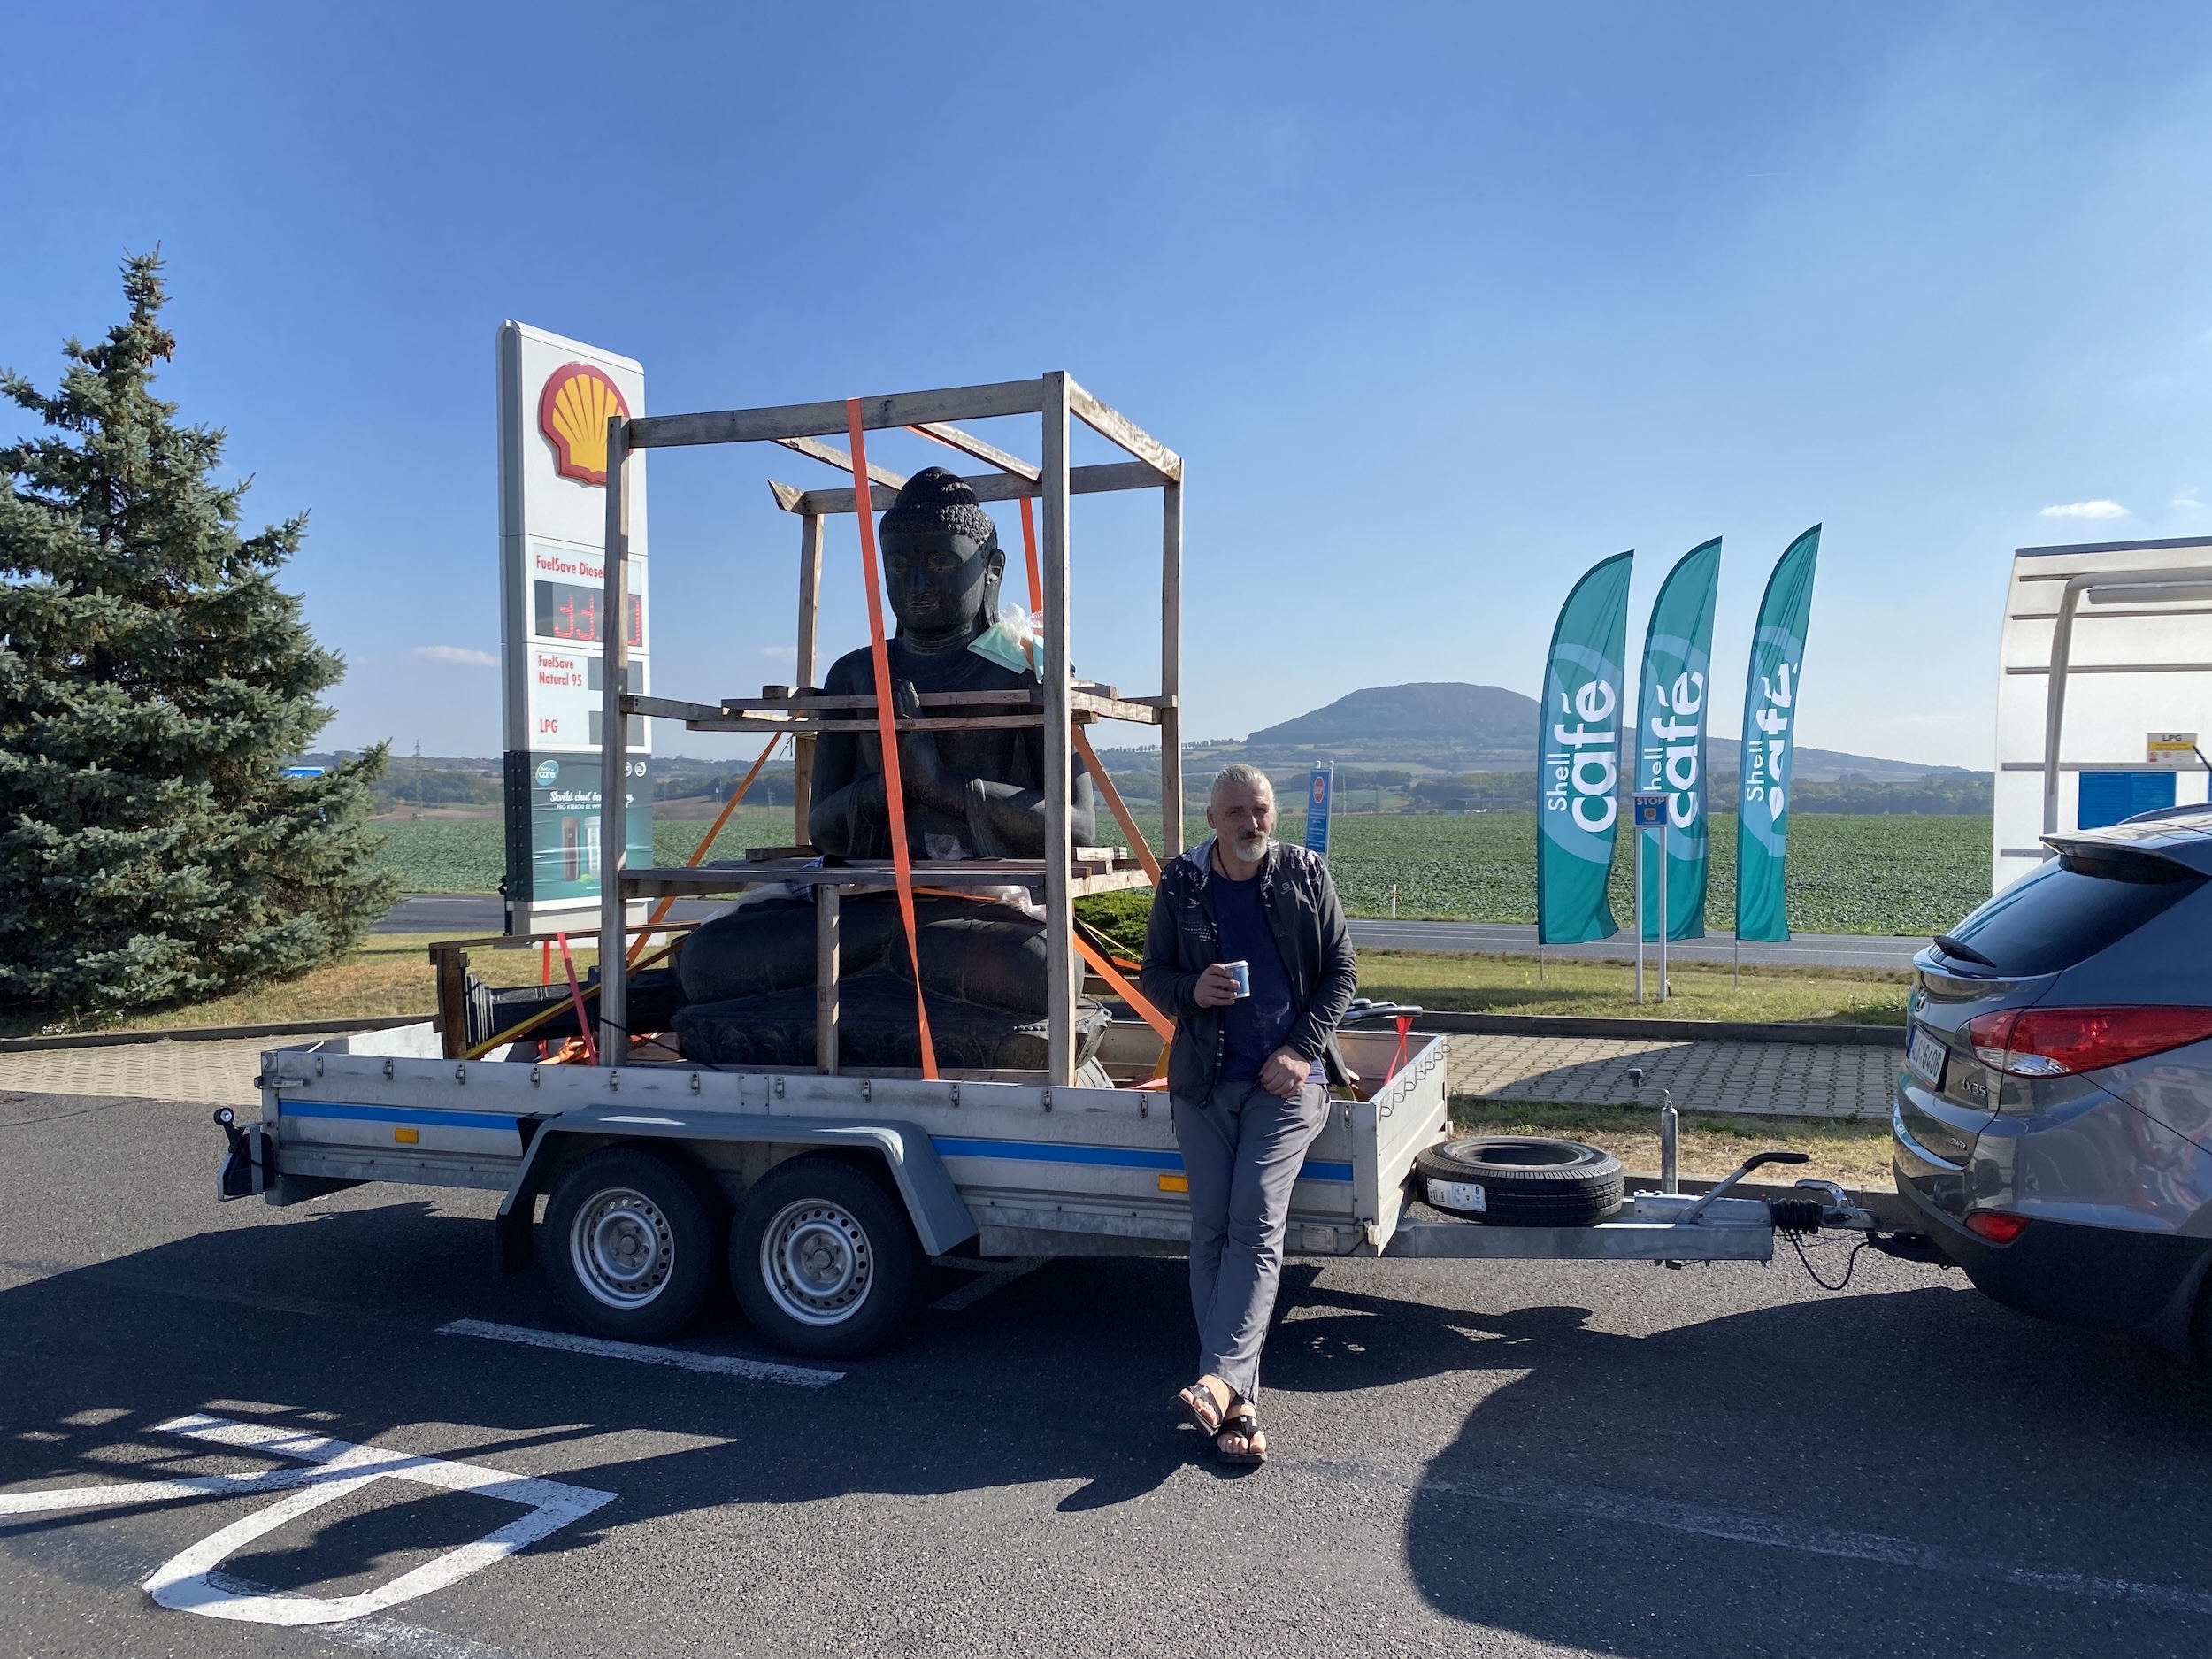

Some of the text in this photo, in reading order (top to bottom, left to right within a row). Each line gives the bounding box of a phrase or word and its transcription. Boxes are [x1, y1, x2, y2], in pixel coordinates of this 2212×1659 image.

[536, 555, 576, 573] FuelSave
[538, 655, 574, 669] FuelSave
[538, 672, 582, 687] Natural 95
[540, 719, 558, 733] LPG
[1554, 680, 1617, 833] café
[1644, 747, 1663, 791] hell
[1651, 671, 1704, 829] café
[1747, 740, 1764, 802] Shell
[1546, 753, 1571, 812] Shell
